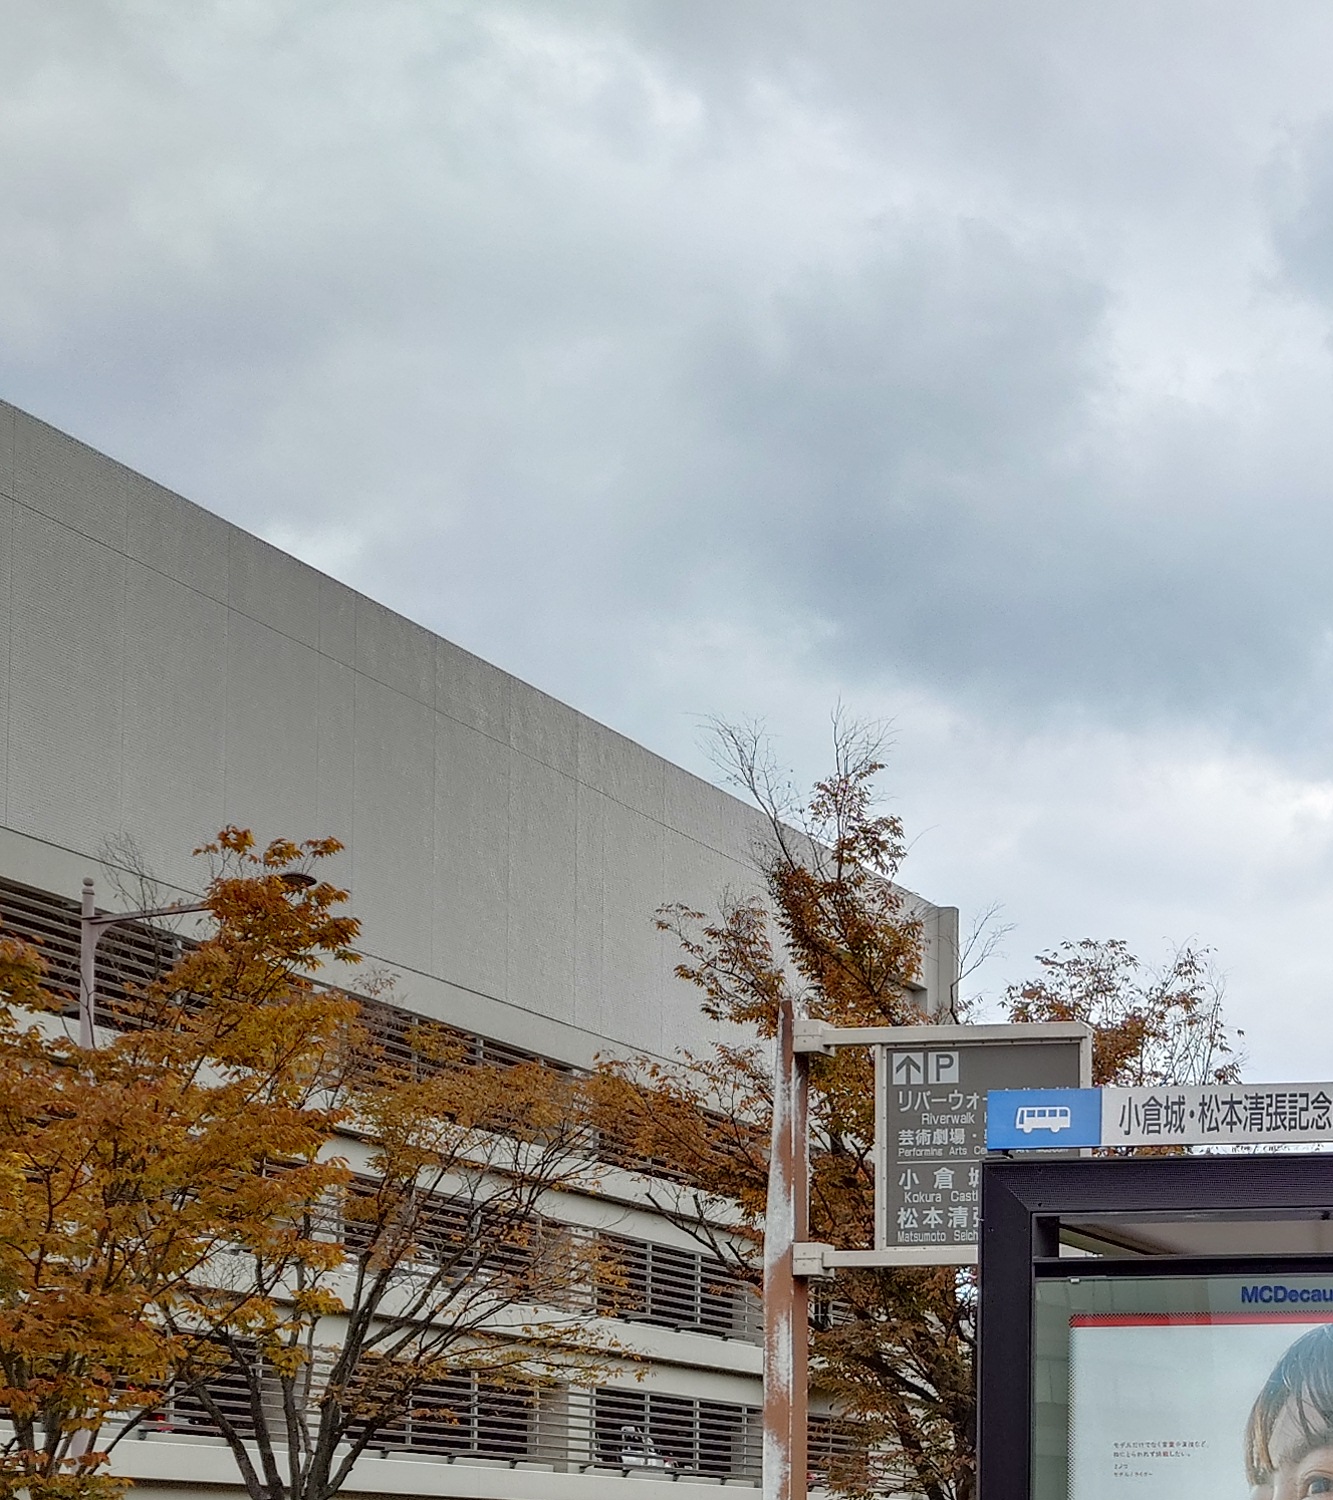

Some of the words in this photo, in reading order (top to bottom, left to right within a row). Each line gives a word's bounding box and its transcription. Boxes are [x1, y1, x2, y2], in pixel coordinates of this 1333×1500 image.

[935, 1053, 955, 1083] P
[898, 1089, 987, 1112] リバーウォ
[921, 1112, 976, 1125] Riverwalk
[898, 1128, 987, 1147] 芸術劇場・
[898, 1147, 944, 1158] Performing
[949, 1145, 968, 1156] Arts
[904, 1190, 943, 1204] Kokura
[897, 1230, 947, 1243] Matsumoto
